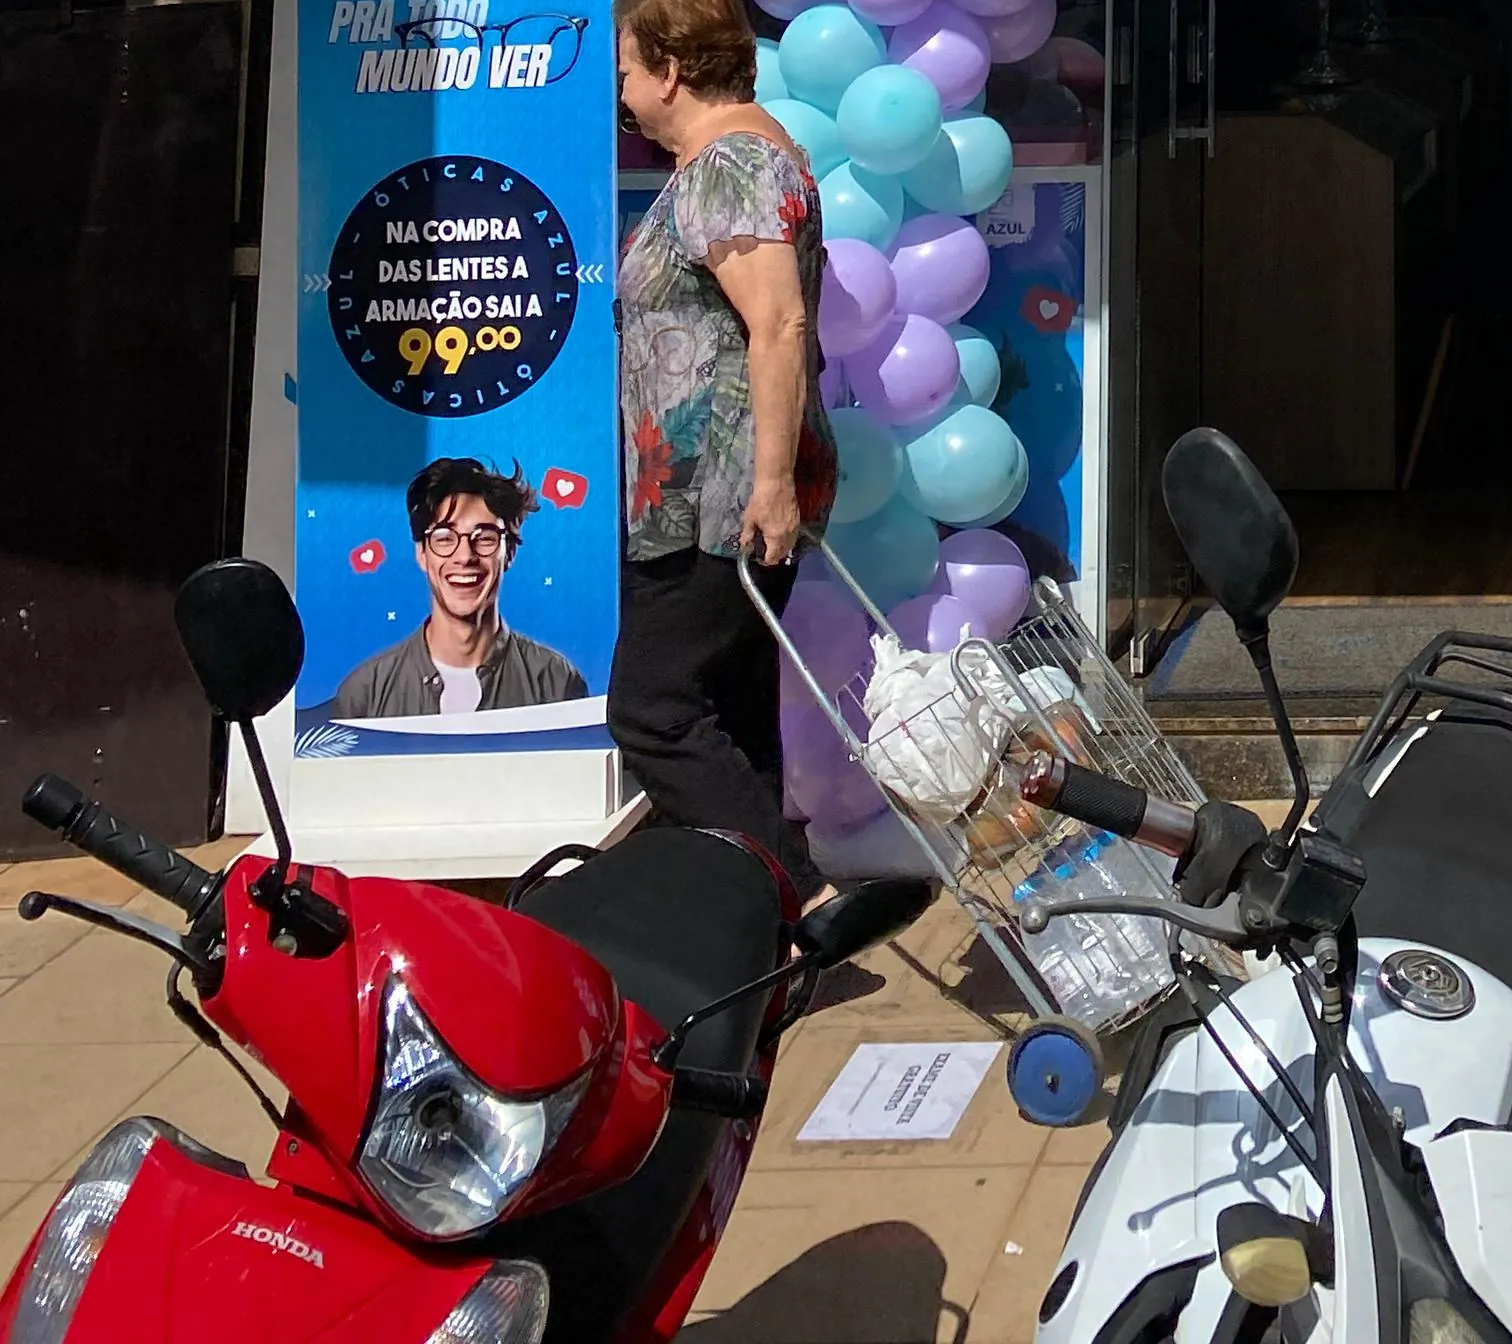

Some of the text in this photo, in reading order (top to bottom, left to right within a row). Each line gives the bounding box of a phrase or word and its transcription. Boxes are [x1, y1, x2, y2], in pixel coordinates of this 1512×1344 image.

[328, 0, 395, 44] PRA
[355, 43, 552, 94] MUNDO VER
[385, 217, 522, 244] NA COMPRA
[986, 223, 1026, 236] AZUL
[378, 255, 529, 283] DAS LENTES A
[365, 290, 543, 324] ARMAÇÃO SAI A
[398, 325, 522, 376] 99,00
[231, 1221, 324, 1269] HONDA
